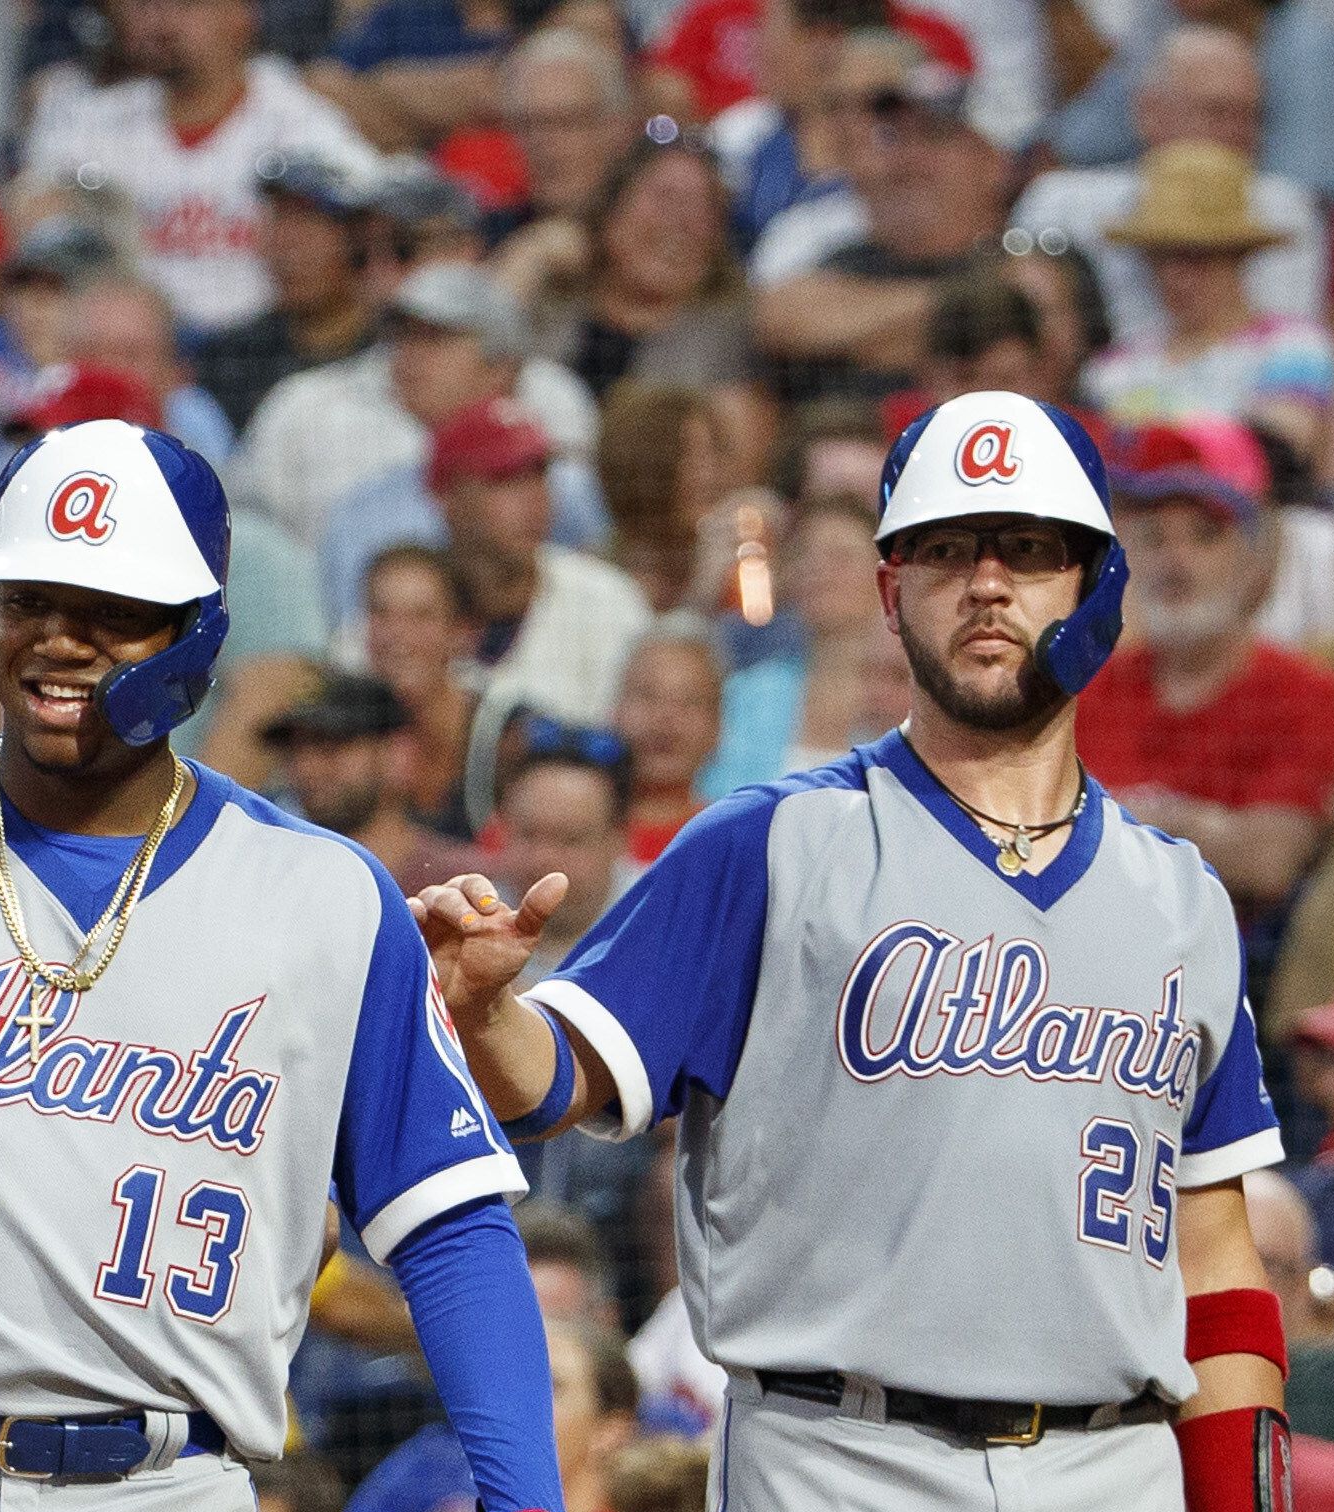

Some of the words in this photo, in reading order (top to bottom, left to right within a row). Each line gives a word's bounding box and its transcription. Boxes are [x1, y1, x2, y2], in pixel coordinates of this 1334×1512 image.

[835, 919, 1201, 1111] Atlanta
[94, 1164, 251, 1325] 13
[1078, 1116, 1178, 1271] 25
